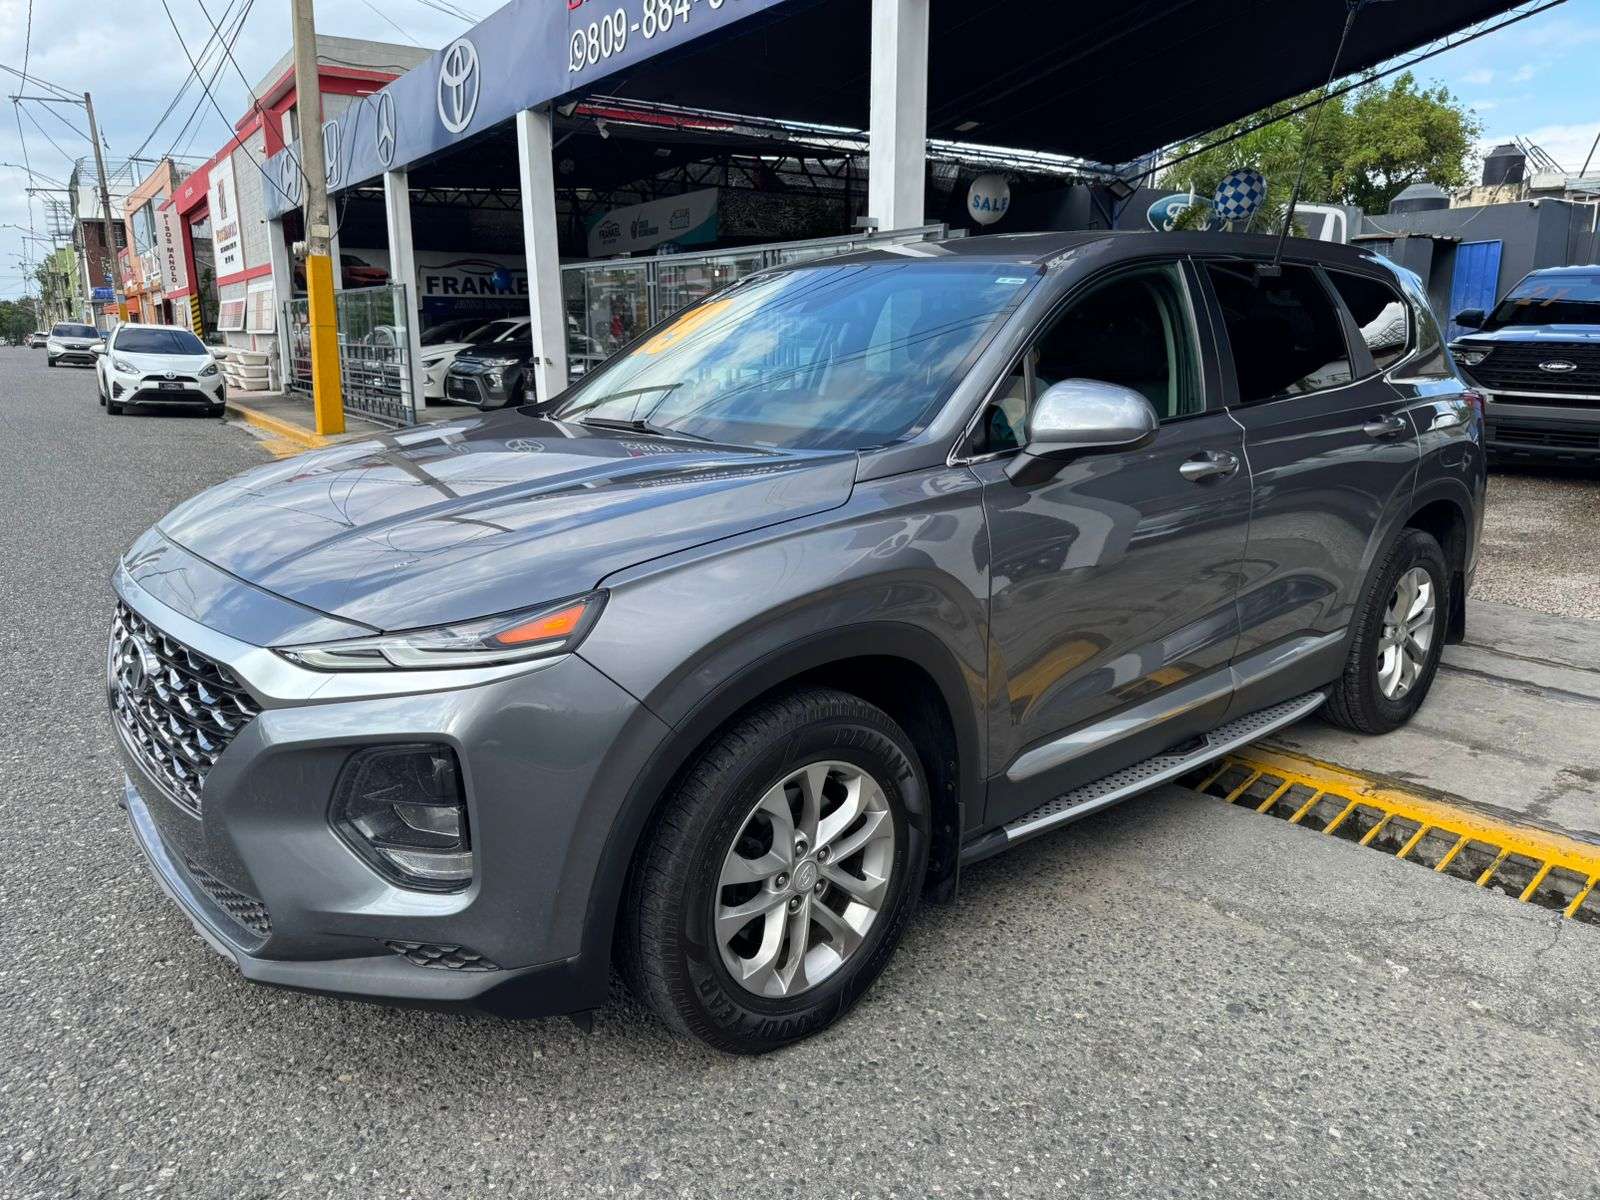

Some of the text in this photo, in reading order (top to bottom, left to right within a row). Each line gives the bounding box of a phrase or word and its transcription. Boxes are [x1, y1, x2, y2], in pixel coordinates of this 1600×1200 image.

[587, 0, 738, 65] 809-884-
[163, 213, 178, 284] PISOS MANOLO
